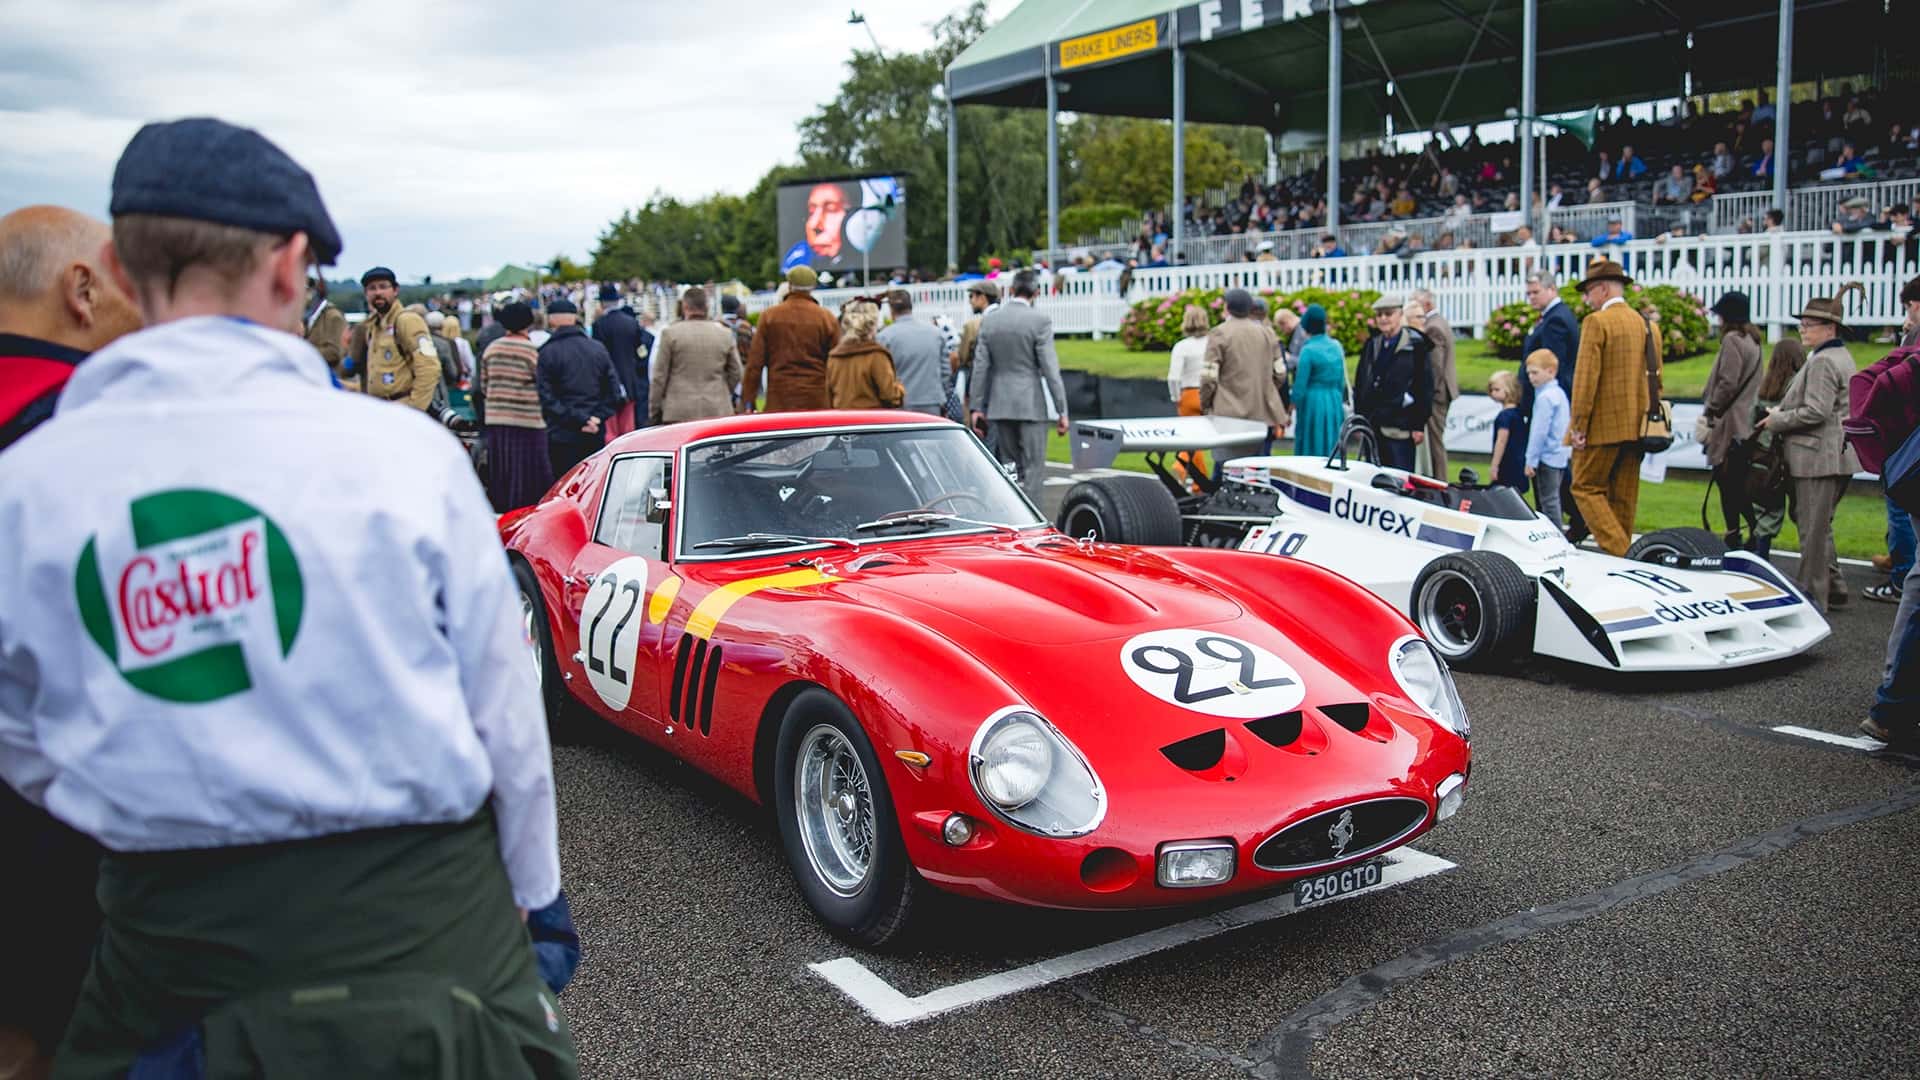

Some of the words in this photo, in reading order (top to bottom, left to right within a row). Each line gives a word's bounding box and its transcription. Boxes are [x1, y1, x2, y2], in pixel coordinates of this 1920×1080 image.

[1065, 38, 1104, 61] BRAKE
[1108, 25, 1153, 52] LINERS
[1335, 488, 1414, 538] durex
[118, 530, 260, 657] Castrol
[1607, 569, 1693, 596] 18
[588, 572, 641, 686] 22
[1655, 599, 1745, 622] durex
[1131, 636, 1297, 704] 22
[1301, 875, 1338, 904] 250
[1341, 864, 1377, 892] GTO
